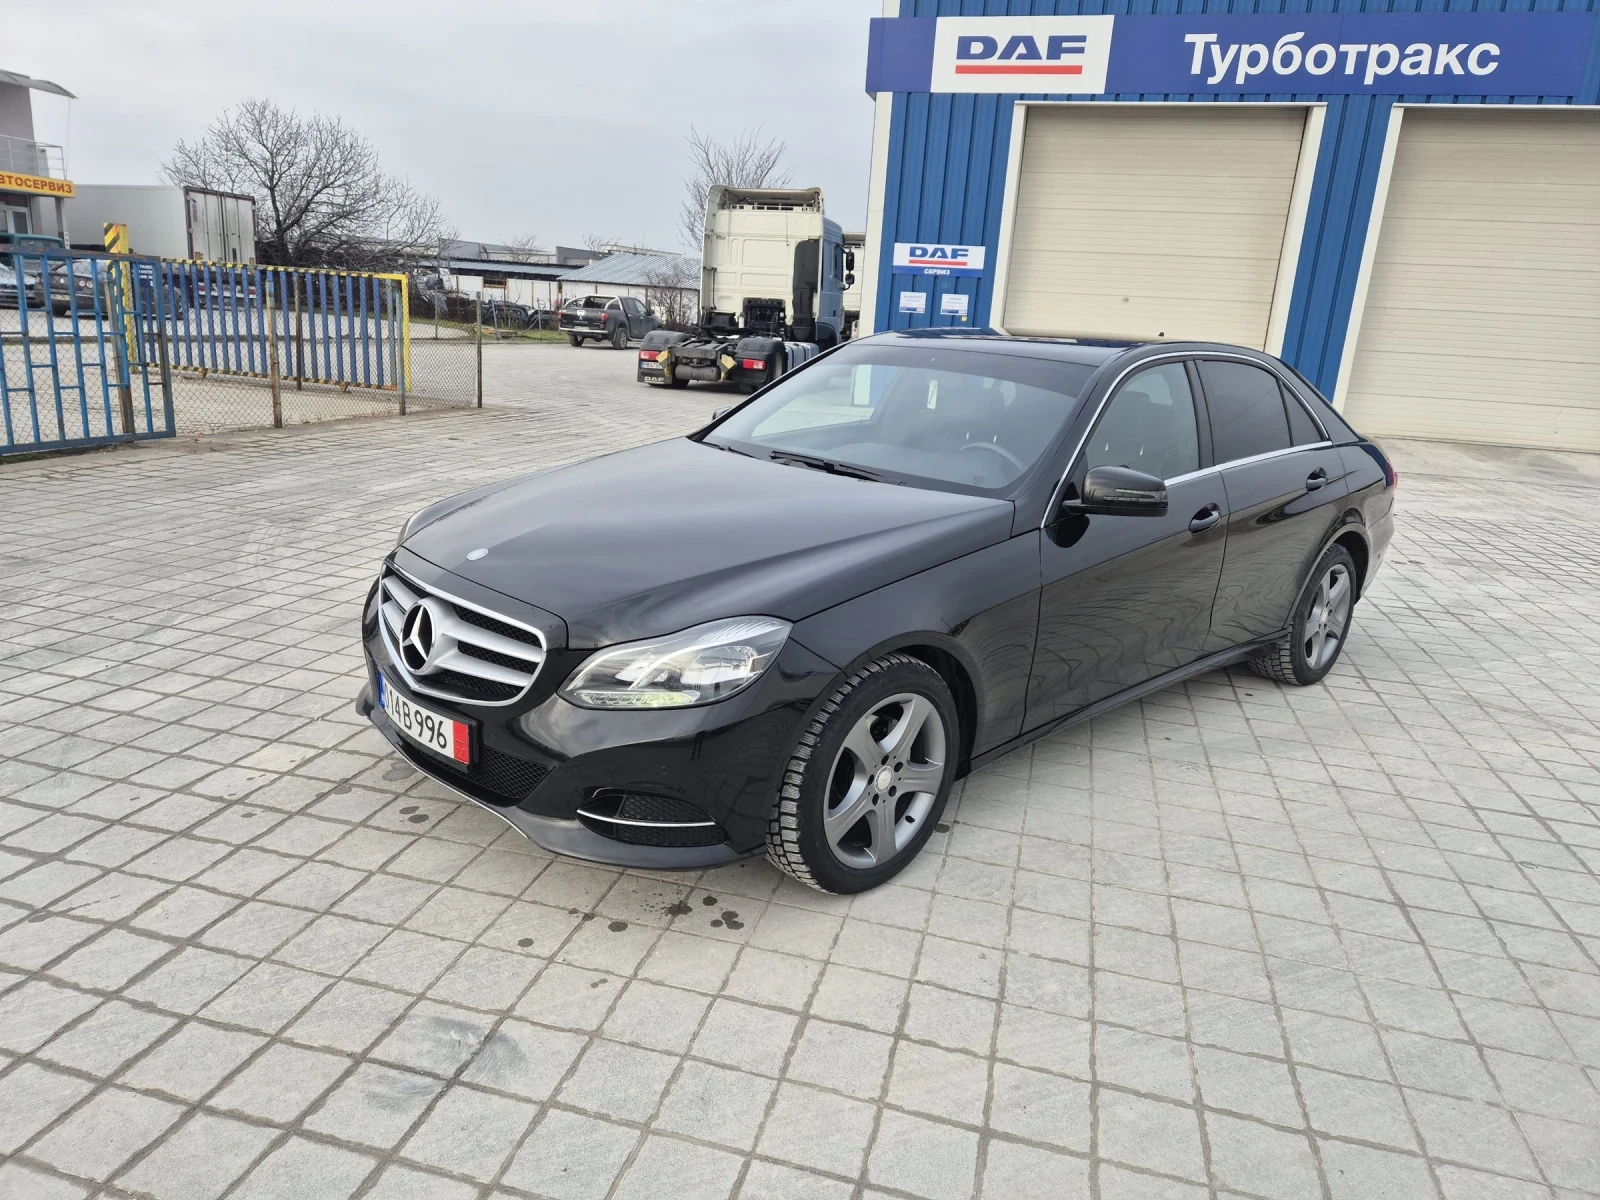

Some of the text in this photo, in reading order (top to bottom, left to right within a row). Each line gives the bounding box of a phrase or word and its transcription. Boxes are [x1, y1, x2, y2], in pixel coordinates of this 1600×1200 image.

[956, 34, 1087, 61] DAF
[1184, 31, 1501, 85] Турботракс
[909, 246, 969, 260] DAF
[924, 268, 950, 276] СЕРВИЗ
